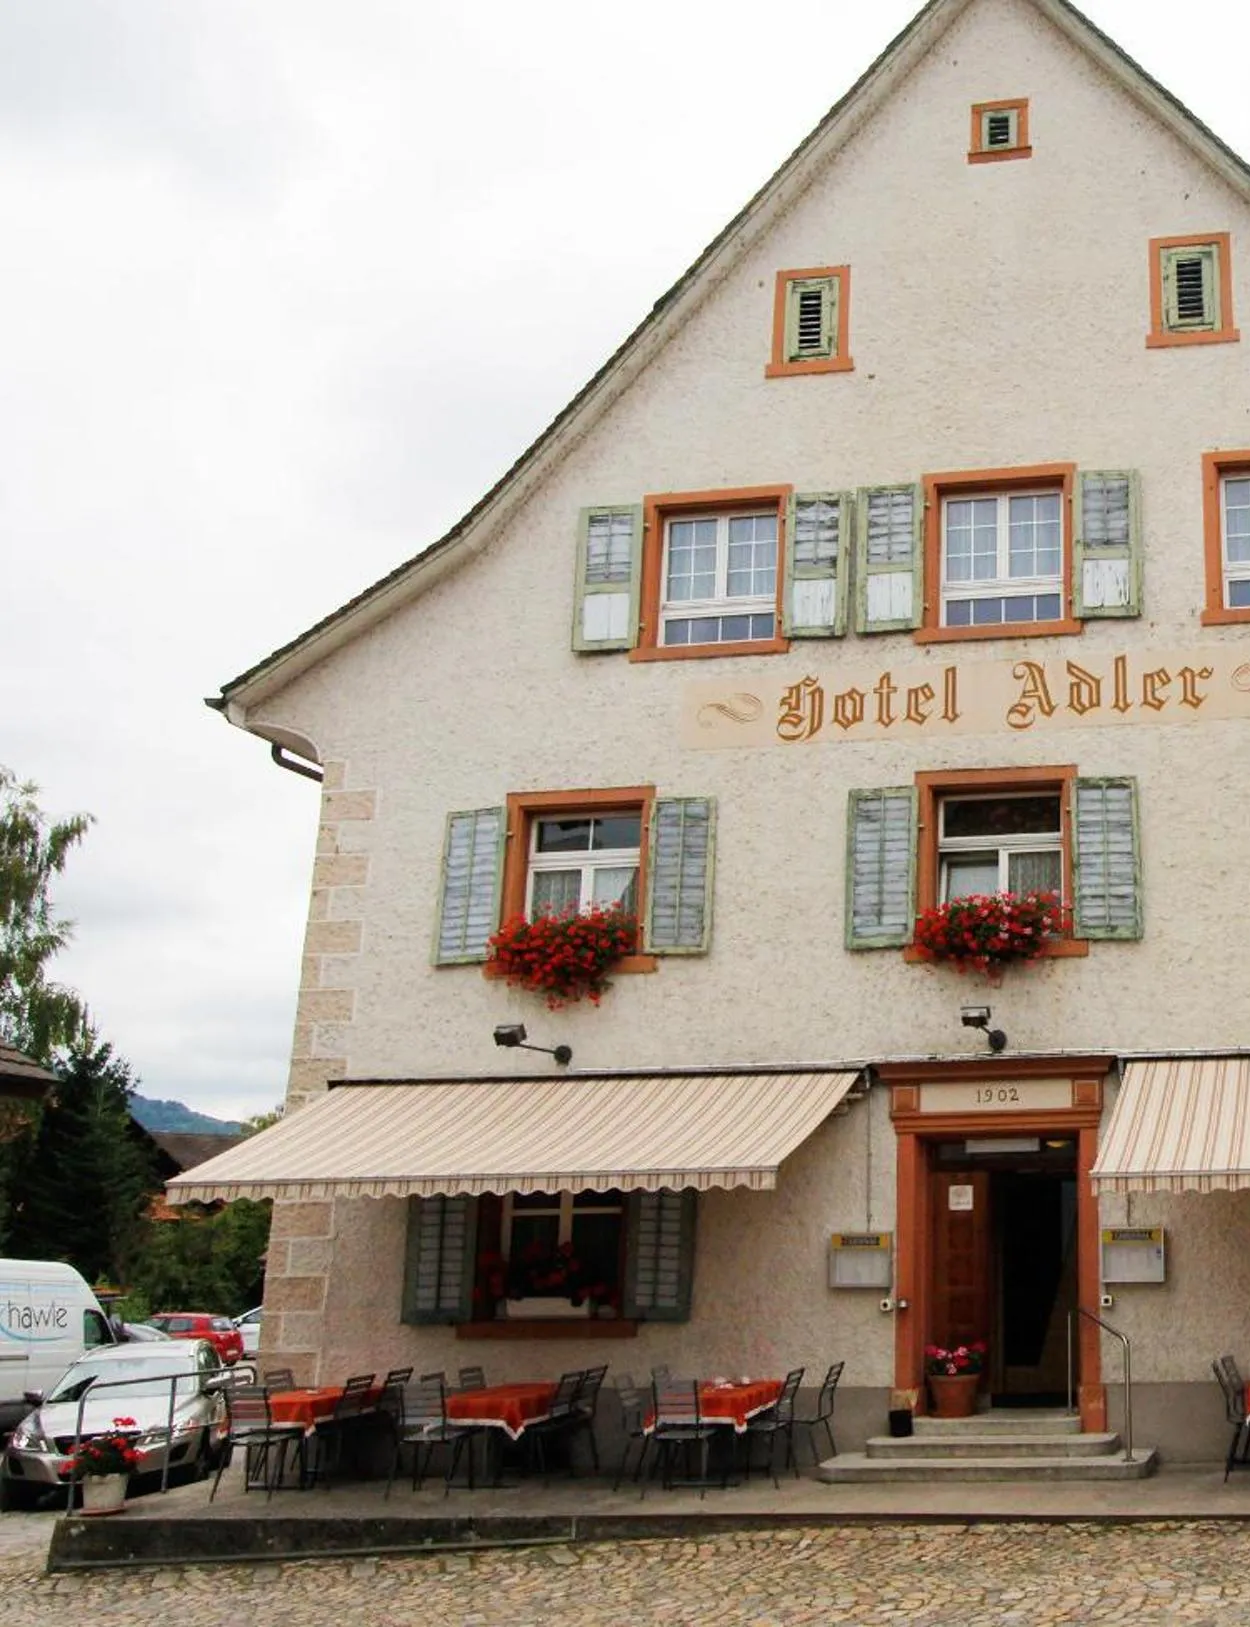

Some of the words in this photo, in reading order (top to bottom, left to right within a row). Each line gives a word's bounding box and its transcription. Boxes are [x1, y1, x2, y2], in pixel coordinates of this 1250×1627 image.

[776, 665, 961, 742] Hotel
[1006, 654, 1214, 729] Adler
[977, 1087, 1019, 1103] 1902
[7, 1300, 68, 1329] hawle
